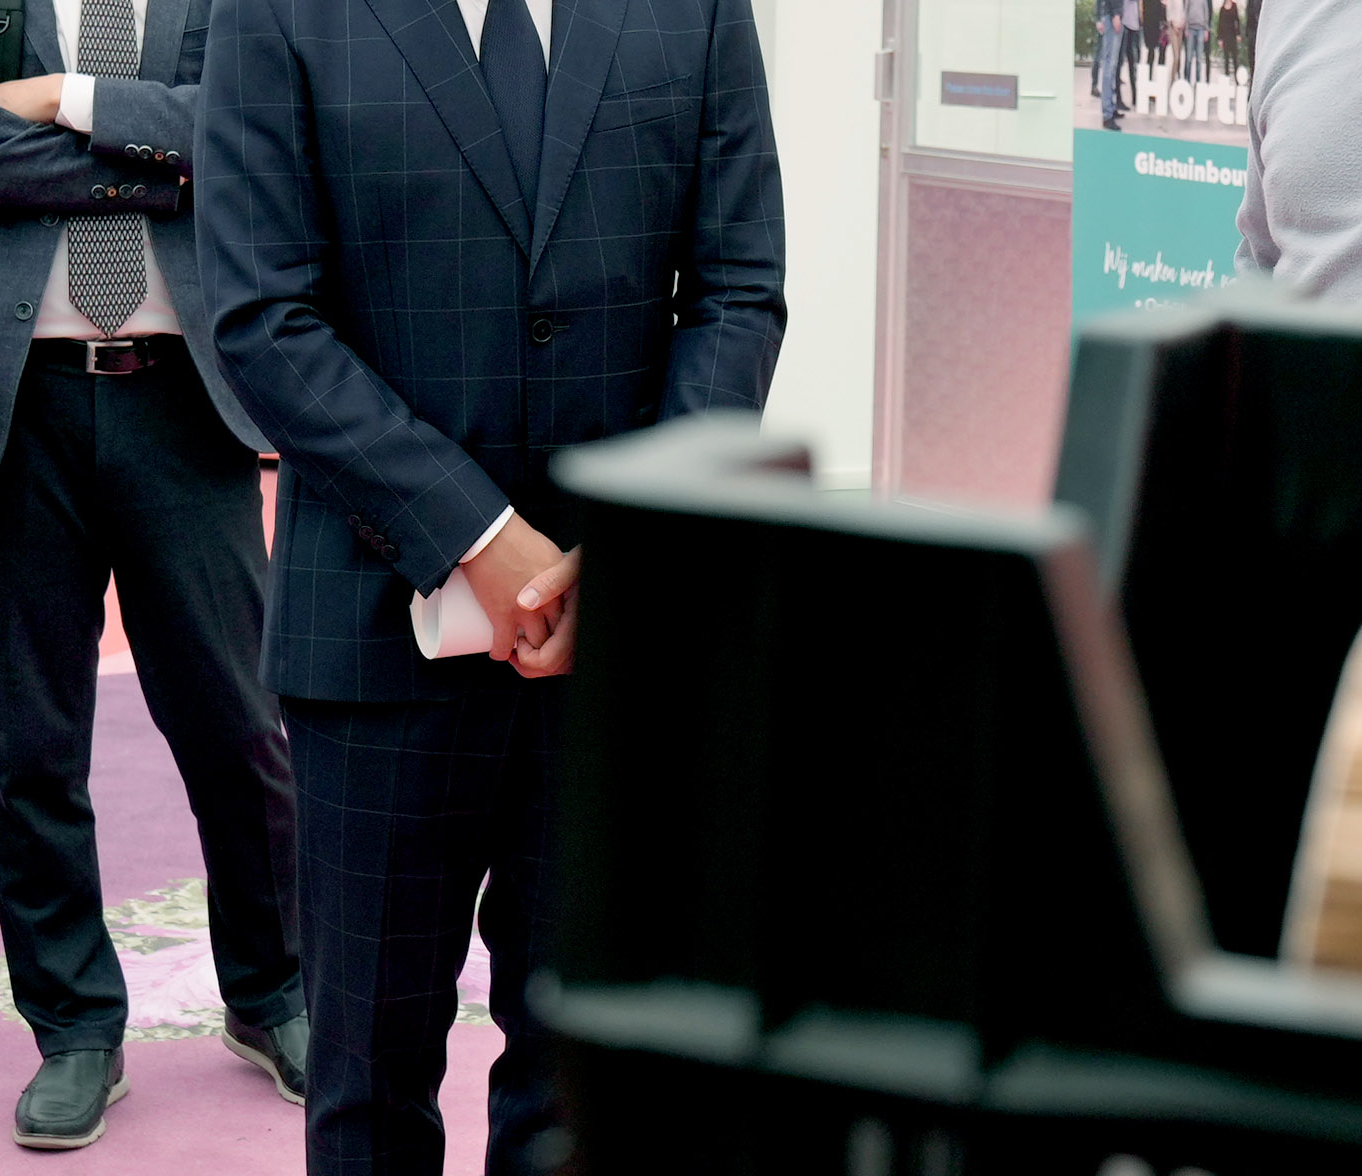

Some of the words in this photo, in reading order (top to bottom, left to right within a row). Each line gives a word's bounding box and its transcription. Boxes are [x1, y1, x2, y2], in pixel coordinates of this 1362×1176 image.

[1136, 63, 1248, 126] Horti
[1134, 151, 1248, 187] Glastuinbou
[1103, 241, 1128, 290] Wij
[1131, 251, 1178, 283] maken
[1179, 259, 1215, 289] werk
